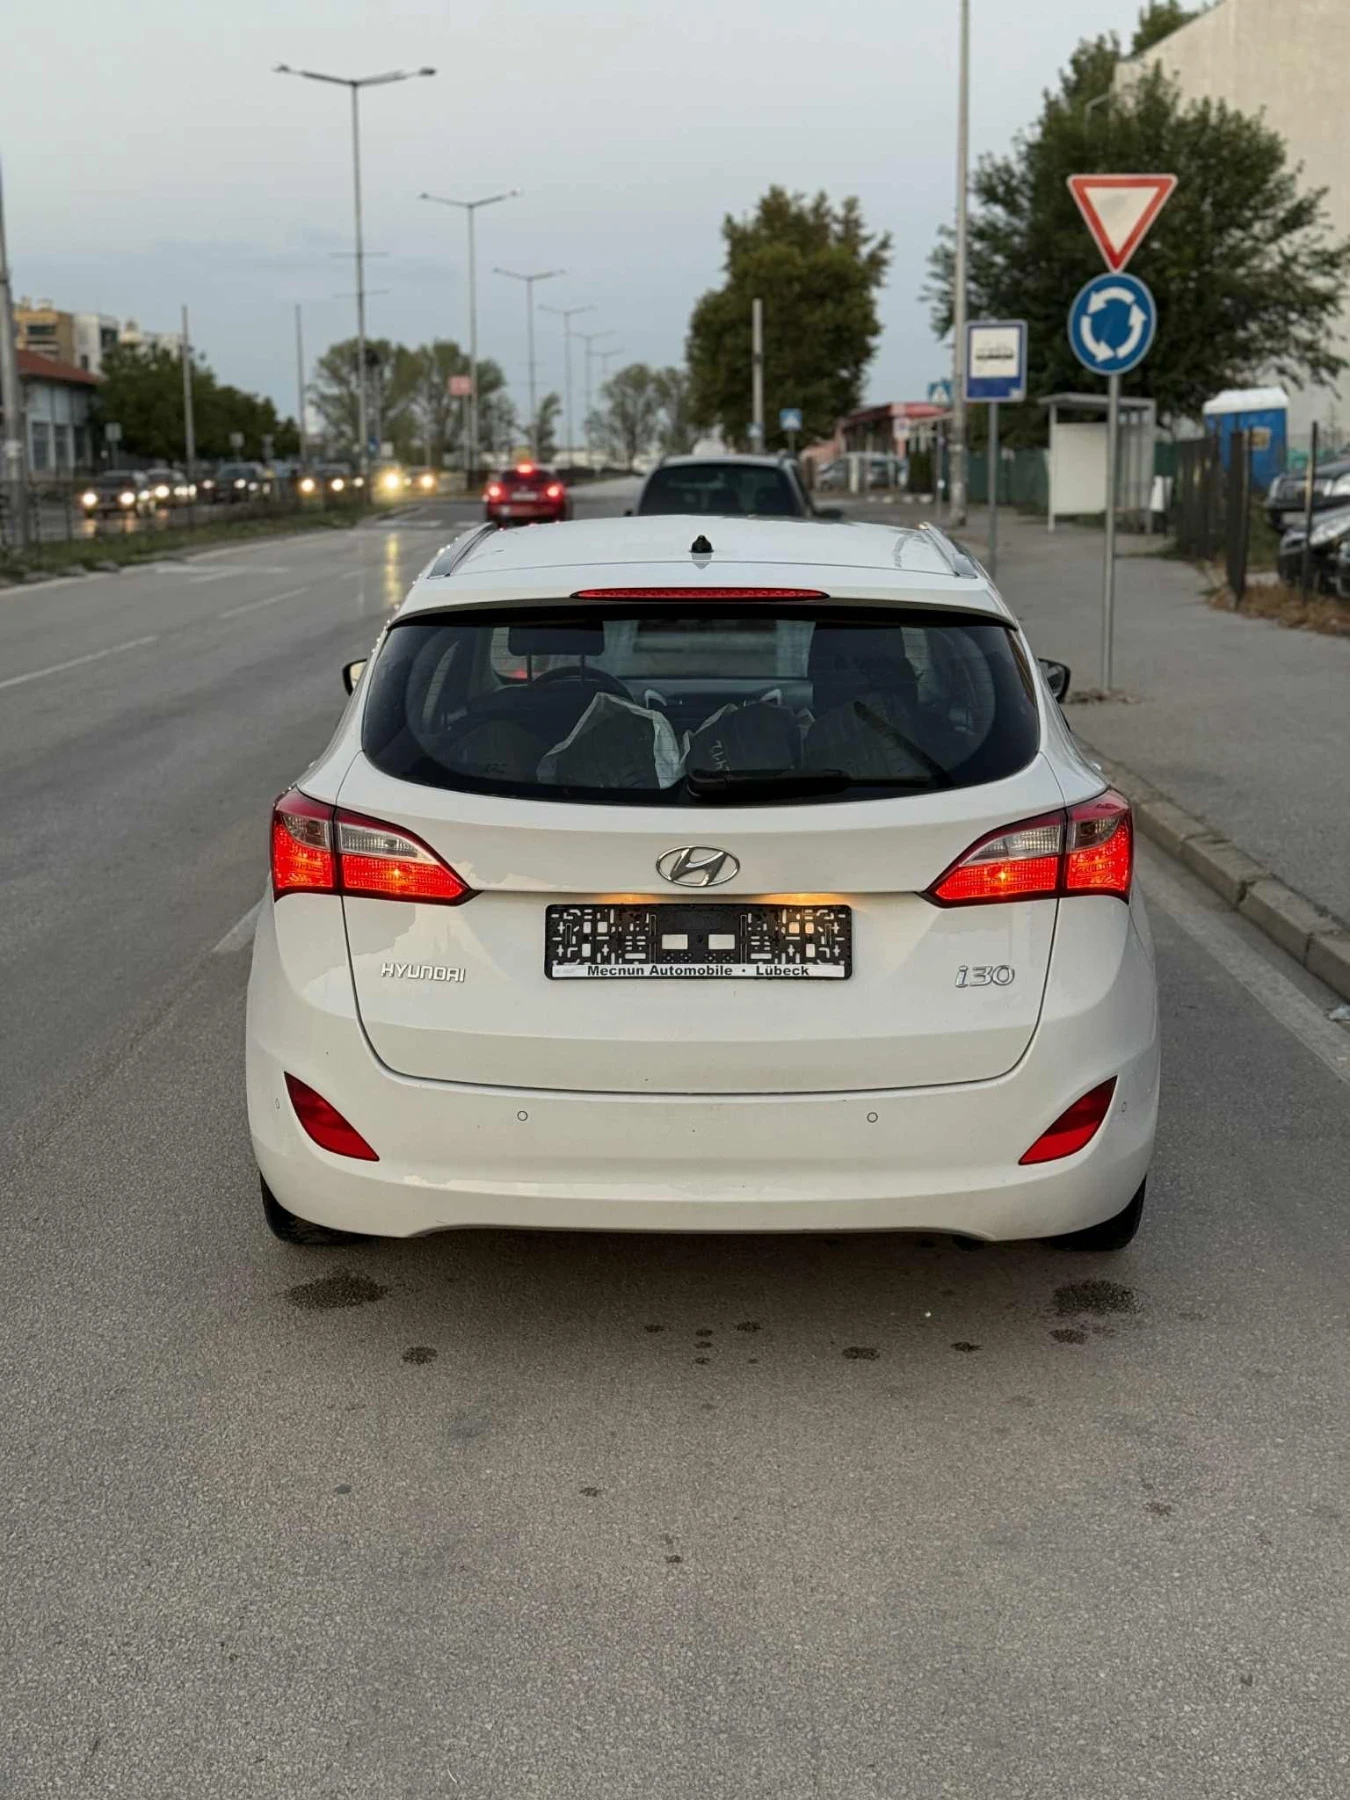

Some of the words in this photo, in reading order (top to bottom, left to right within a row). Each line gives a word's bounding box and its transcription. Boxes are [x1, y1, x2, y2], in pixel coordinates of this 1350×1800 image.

[381, 963, 466, 982] HYUNDAI
[587, 965, 645, 976] Mecnun
[649, 965, 733, 976] Automobile
[755, 964, 810, 976] Lübeck
[955, 965, 1015, 988] i30
